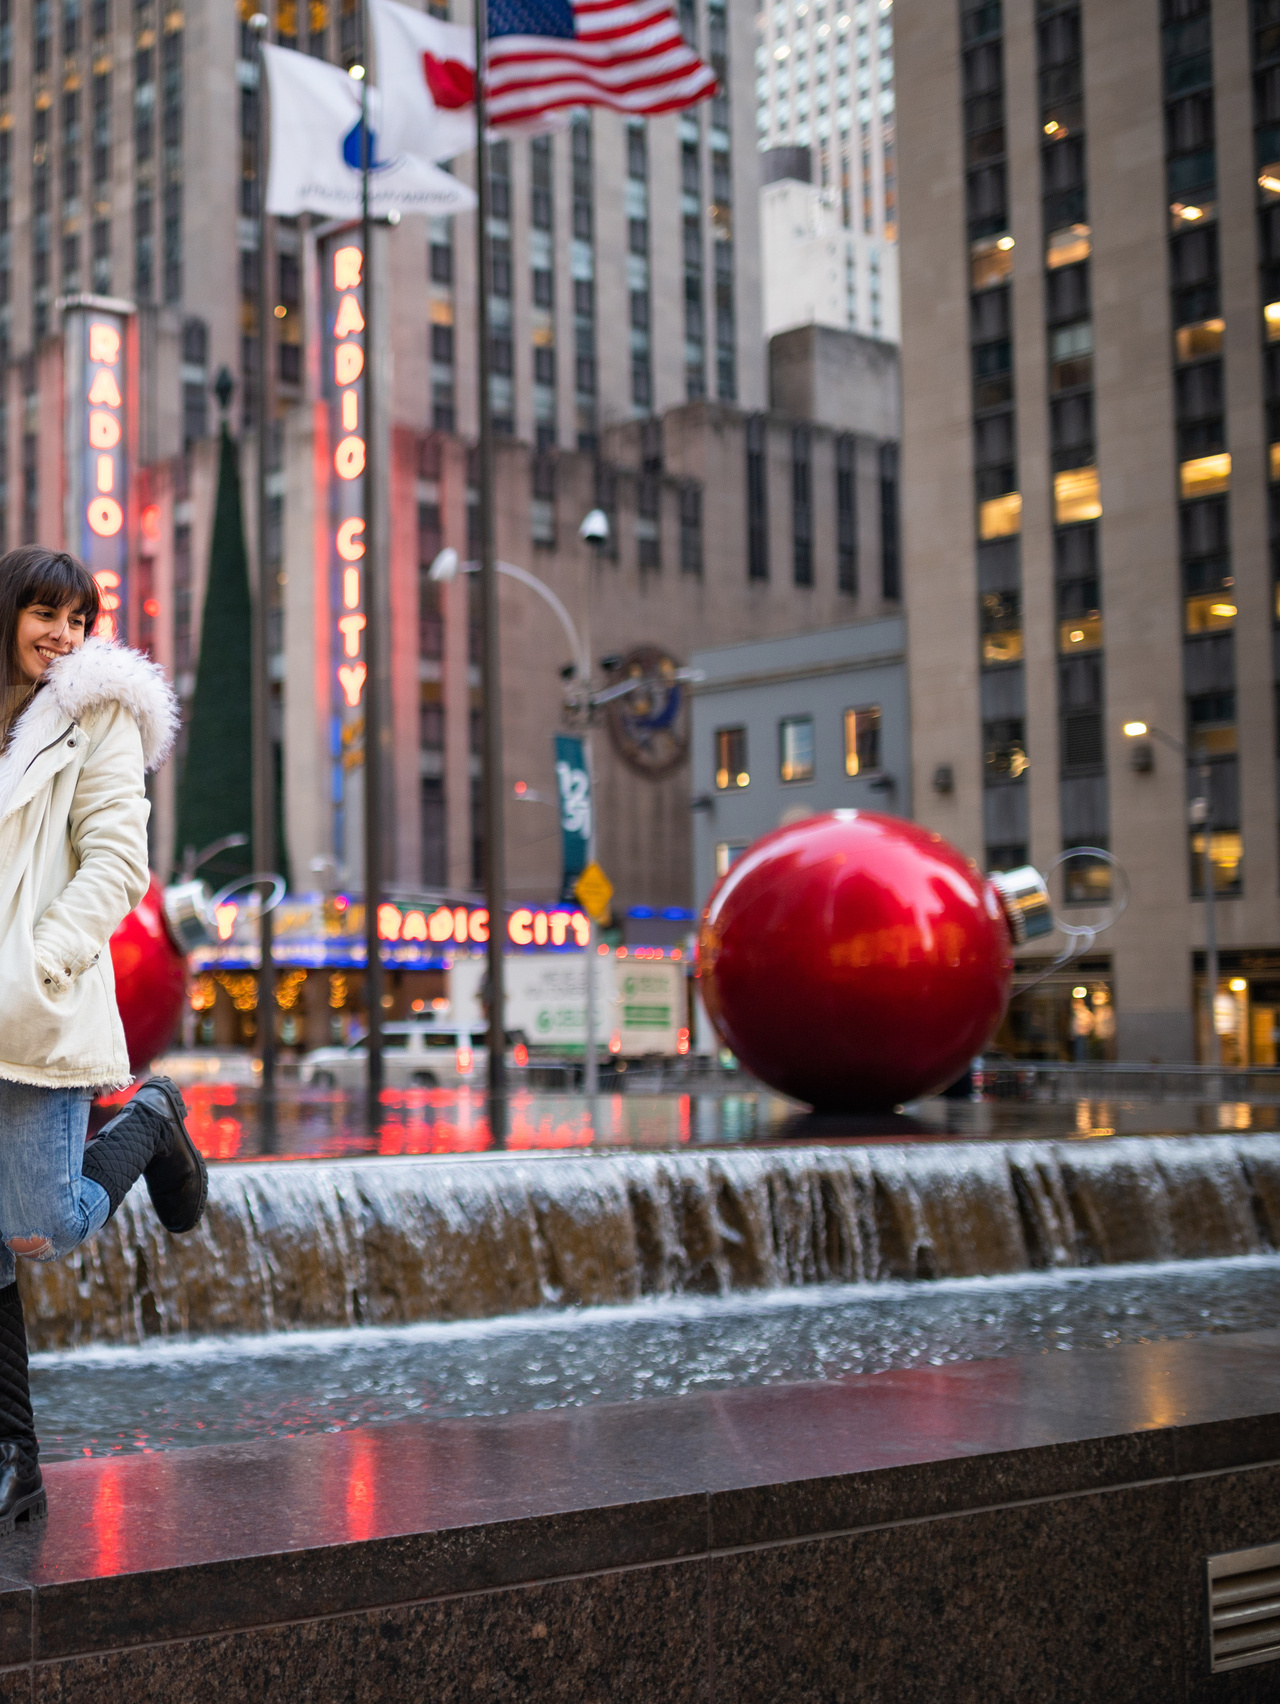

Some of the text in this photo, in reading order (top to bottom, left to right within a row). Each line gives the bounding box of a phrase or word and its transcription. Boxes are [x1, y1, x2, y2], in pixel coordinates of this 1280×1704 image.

[88, 323, 124, 537] RADIO
[334, 246, 365, 481] RADIO
[336, 516, 367, 707] CITY
[508, 908, 590, 946] CITY
